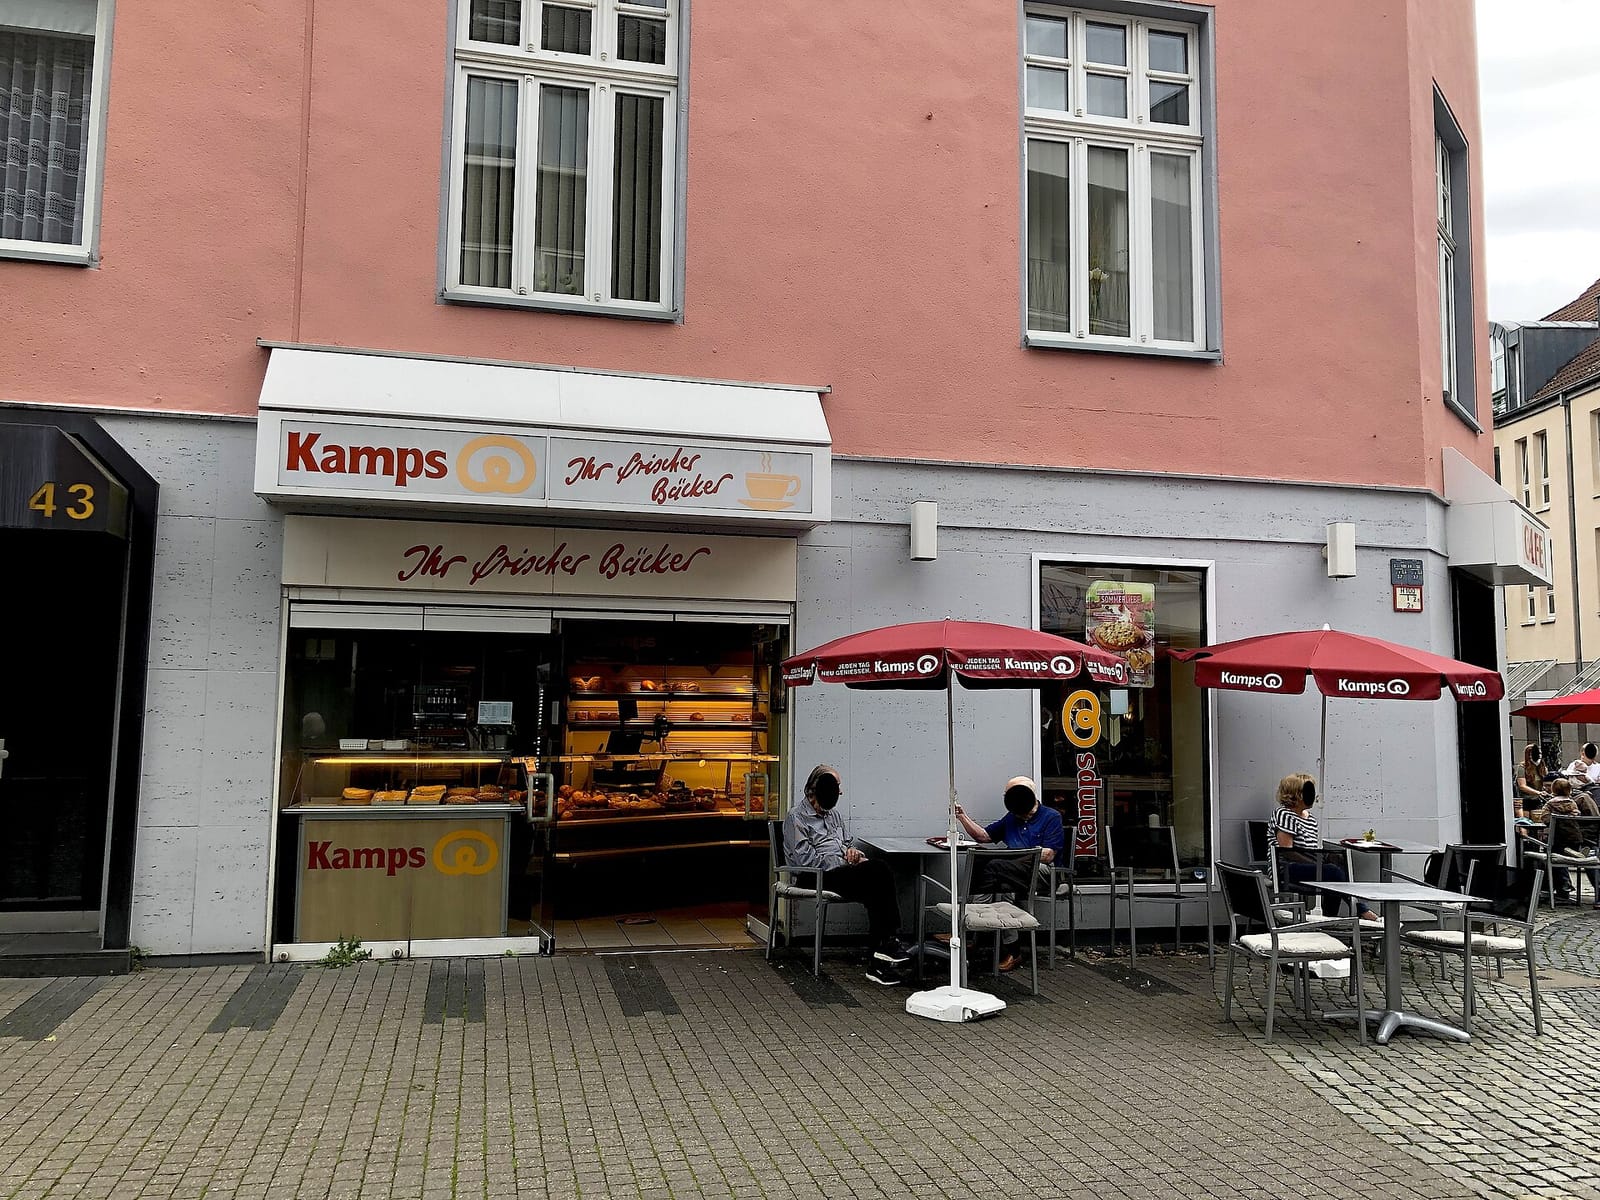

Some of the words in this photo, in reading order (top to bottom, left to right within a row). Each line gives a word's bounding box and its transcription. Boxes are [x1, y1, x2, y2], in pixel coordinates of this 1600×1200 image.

[286, 431, 449, 487] Kamps
[565, 456, 613, 485] Ihr
[617, 447, 701, 484] frischer
[28, 480, 95, 520] 43
[651, 474, 733, 504] Bäcker
[397, 544, 467, 582] Ihr
[469, 542, 590, 585] frischer
[599, 543, 711, 580] Bäcker
[874, 660, 915, 674] Kamps
[1004, 658, 1049, 673] Kamps
[1221, 671, 1262, 687] Kamps
[1338, 679, 1386, 694] Kamps
[1075, 751, 1102, 857] Kamps
[307, 840, 426, 877] Kamps
